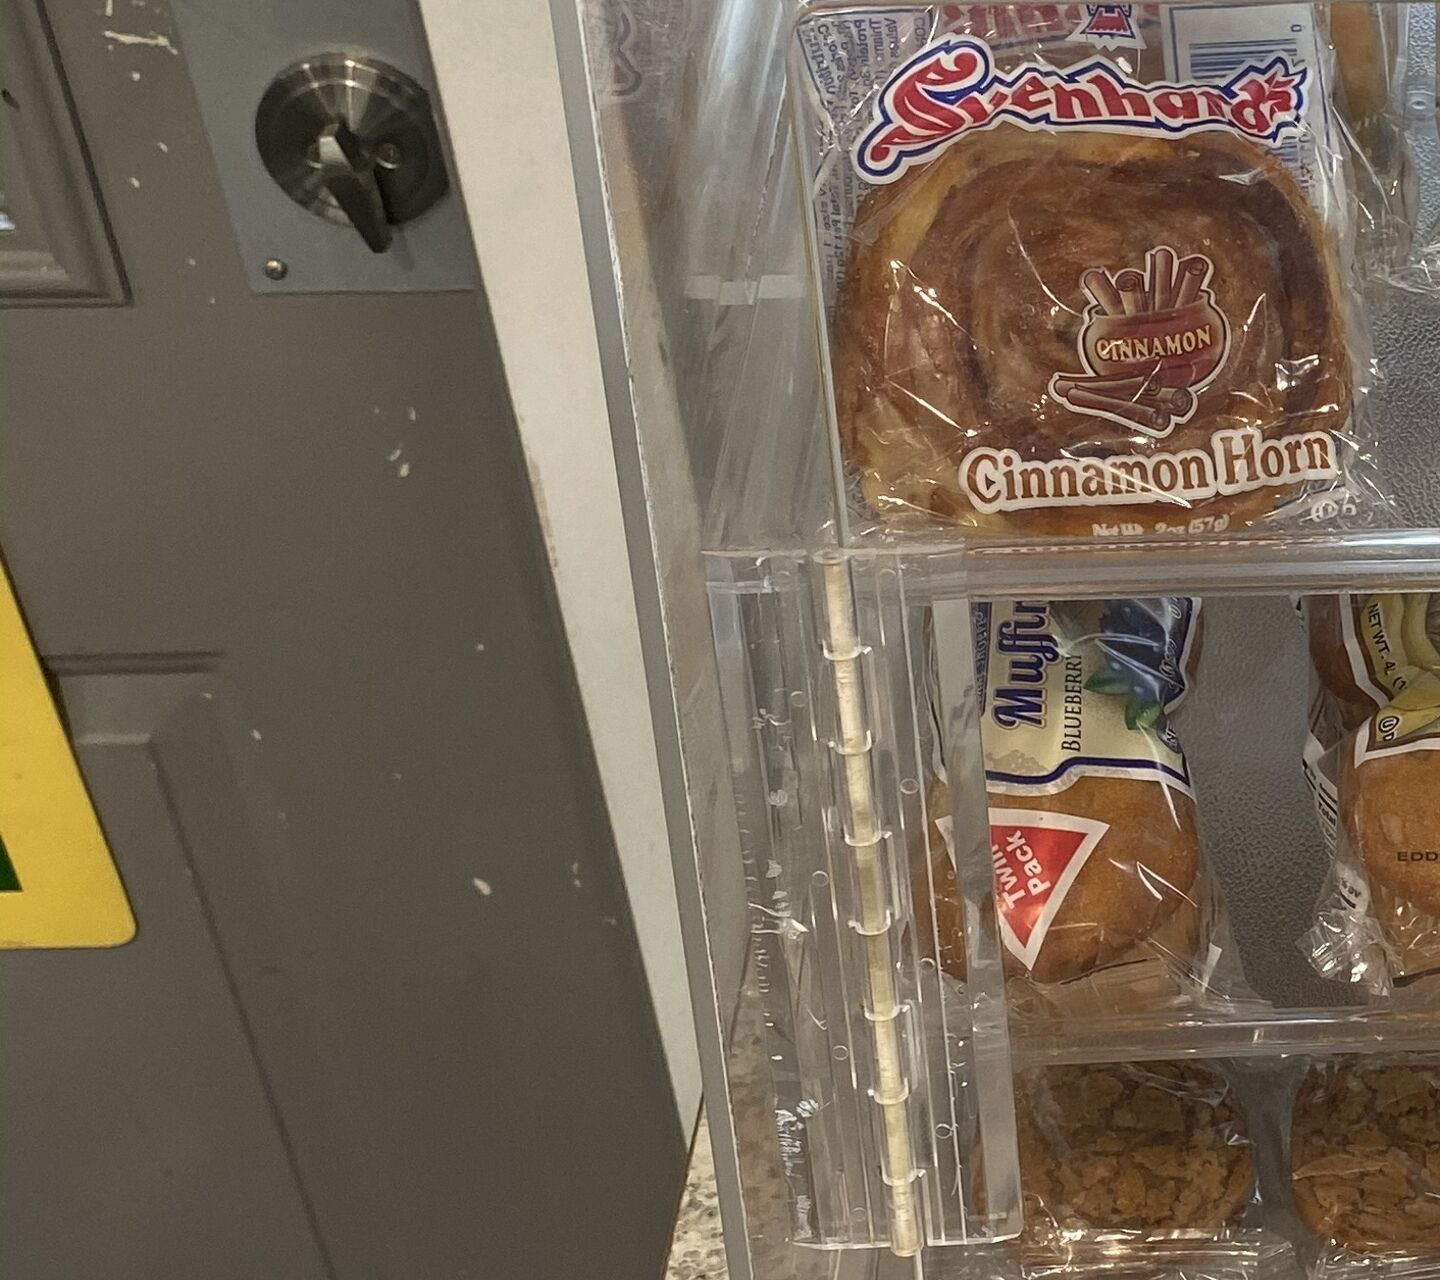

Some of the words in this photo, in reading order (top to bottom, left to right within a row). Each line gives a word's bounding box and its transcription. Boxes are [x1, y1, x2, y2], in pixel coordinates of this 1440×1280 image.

[868, 50, 1300, 164] Svenhard's
[1096, 325, 1212, 361] CINNAMON
[966, 450, 1216, 501] Cinnamon
[1218, 431, 1332, 485] Horn
[1366, 604, 1381, 632] NET
[1373, 633, 1390, 661] WT.
[1008, 829, 1052, 896] Pack
